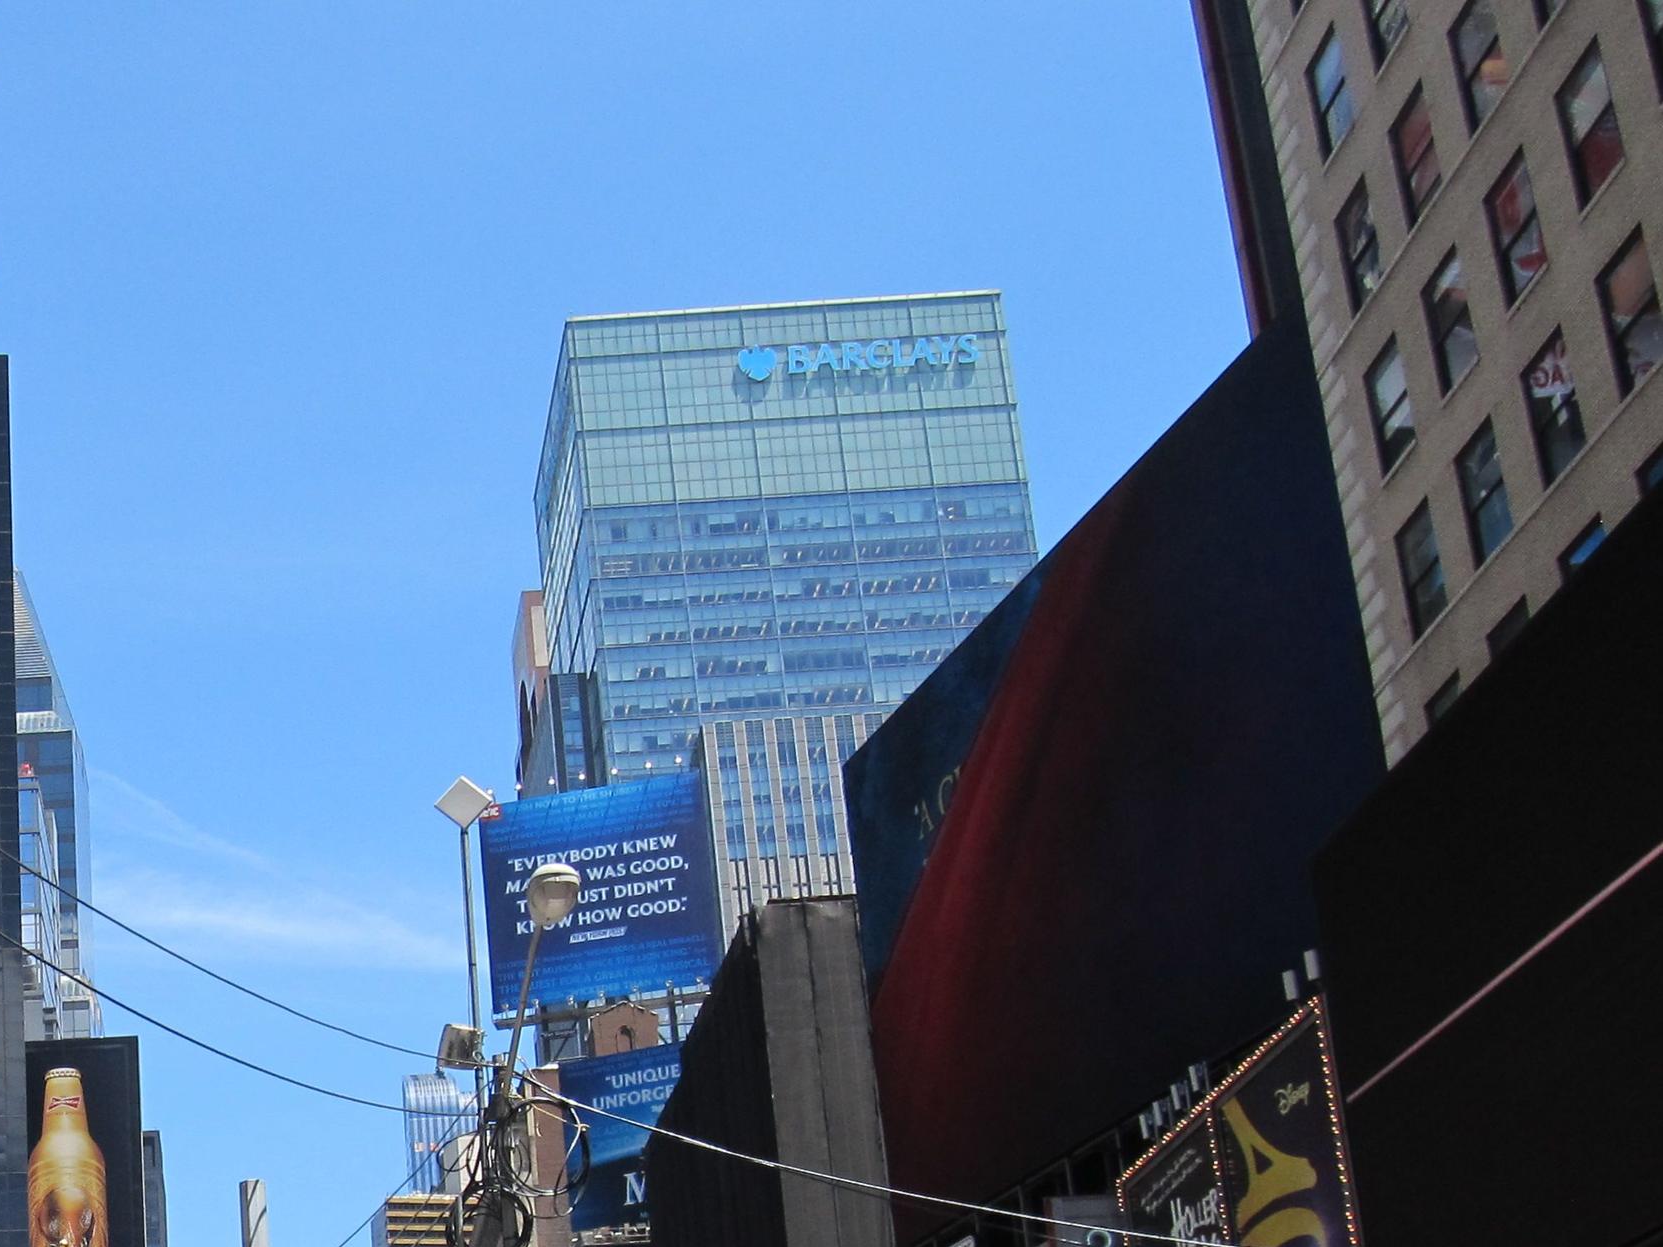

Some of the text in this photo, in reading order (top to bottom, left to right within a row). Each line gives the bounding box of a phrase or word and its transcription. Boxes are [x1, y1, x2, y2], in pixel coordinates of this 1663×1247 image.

[787, 334, 979, 375] BARCLAYS
[508, 843, 618, 872] "EVERYBODY
[623, 834, 678, 855] KNEW
[587, 855, 690, 881] WAS GOOD,
[577, 877, 677, 905] UST DIDN'T
[578, 896, 688, 925] HOW GOOD."
[605, 1063, 682, 1089] "UNIQUE
[1169, 1187, 1221, 1236] HOLLER
